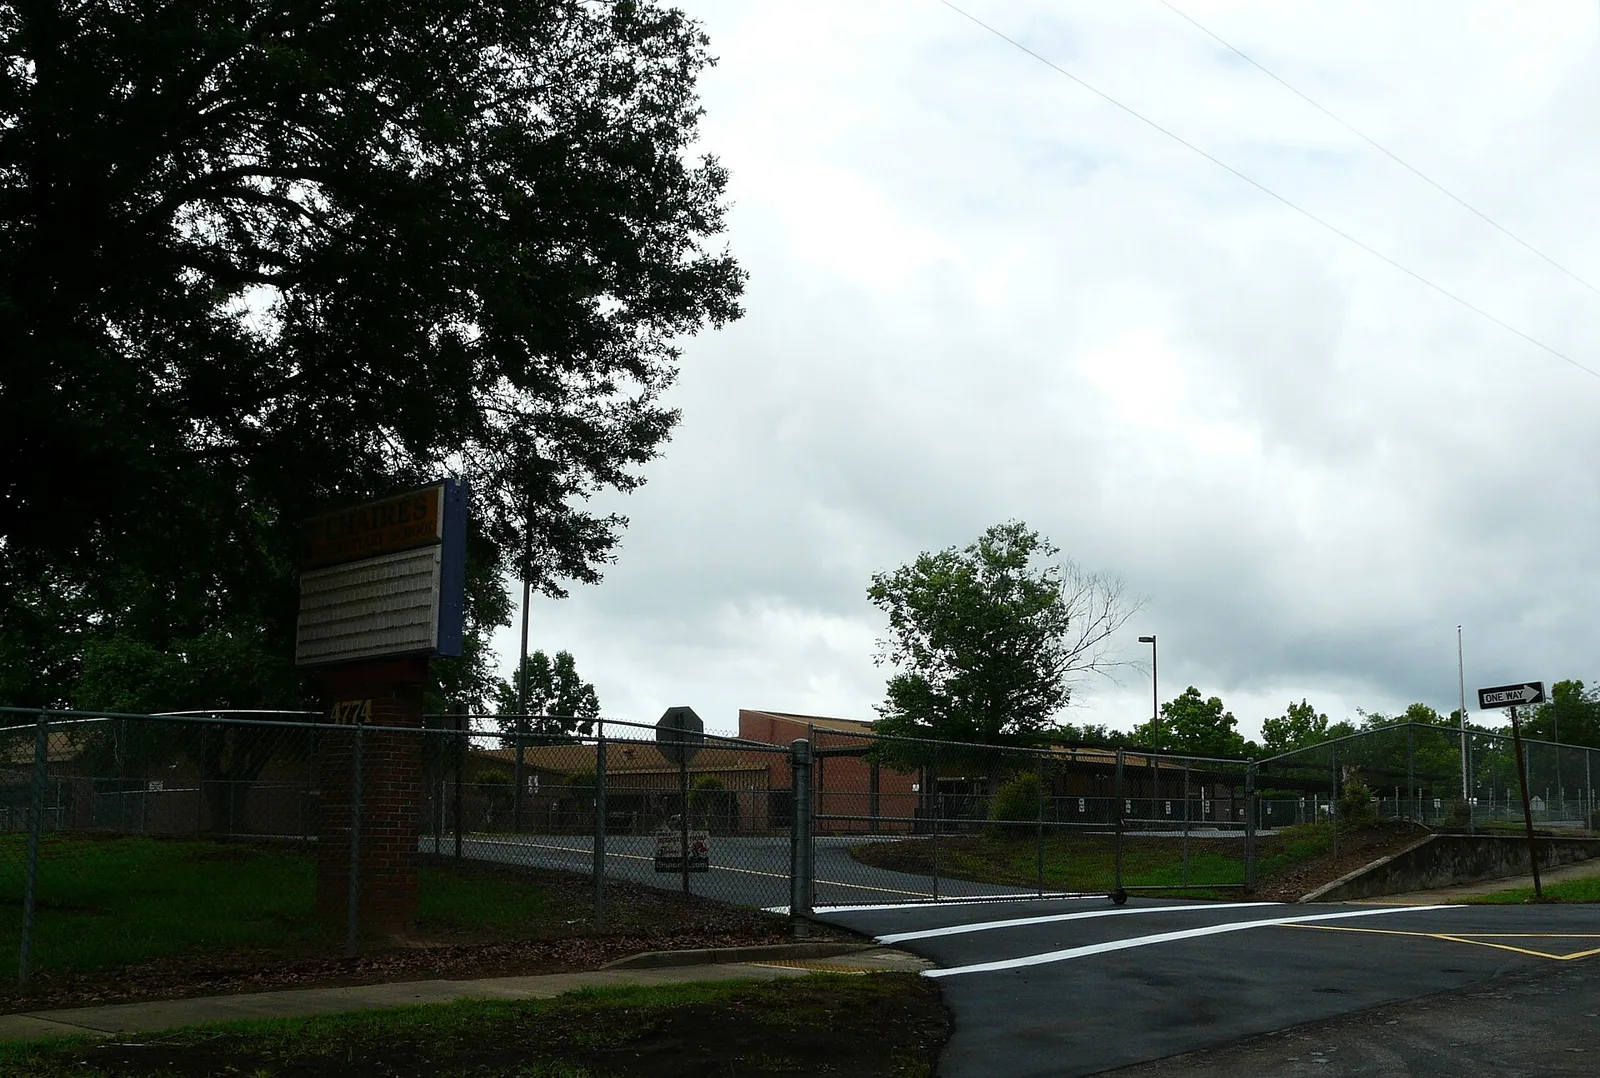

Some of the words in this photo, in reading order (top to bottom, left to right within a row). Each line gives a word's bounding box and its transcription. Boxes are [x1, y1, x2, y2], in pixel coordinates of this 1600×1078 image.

[324, 496, 428, 540] CHAIRES
[389, 519, 436, 543] SCHOOL
[1486, 693, 1503, 703] ONE
[1505, 690, 1523, 700] WAY
[330, 699, 372, 724] 4774
